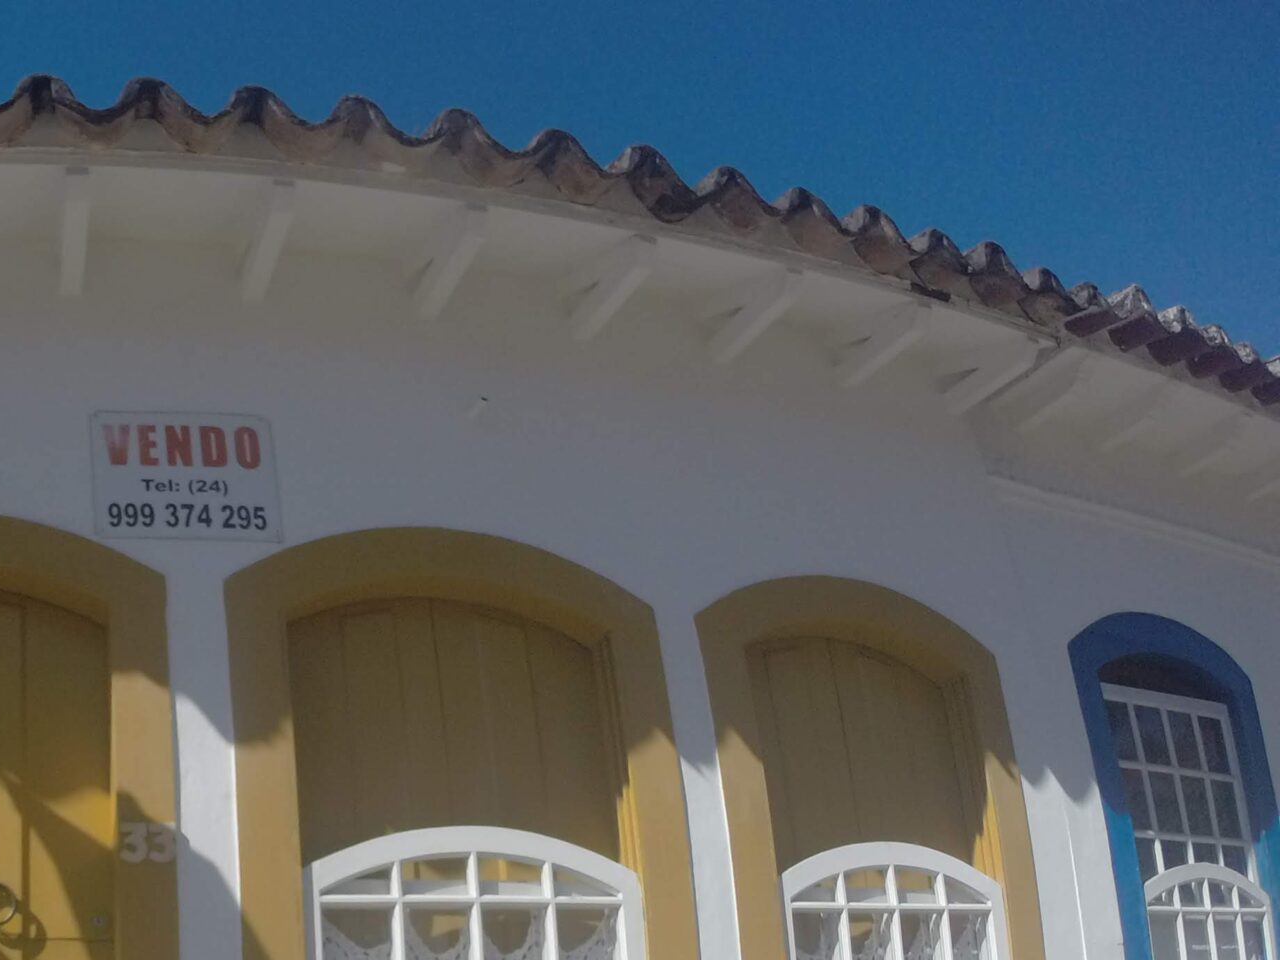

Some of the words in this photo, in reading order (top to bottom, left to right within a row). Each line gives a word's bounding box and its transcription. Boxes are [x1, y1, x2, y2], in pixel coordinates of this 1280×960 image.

[103, 425, 261, 469] VENDO
[141, 479, 180, 492] Tel:
[188, 480, 229, 496] (24)
[108, 503, 155, 527] 999
[165, 504, 212, 528] 374
[222, 505, 267, 531] 295
[120, 822, 176, 863] 33
